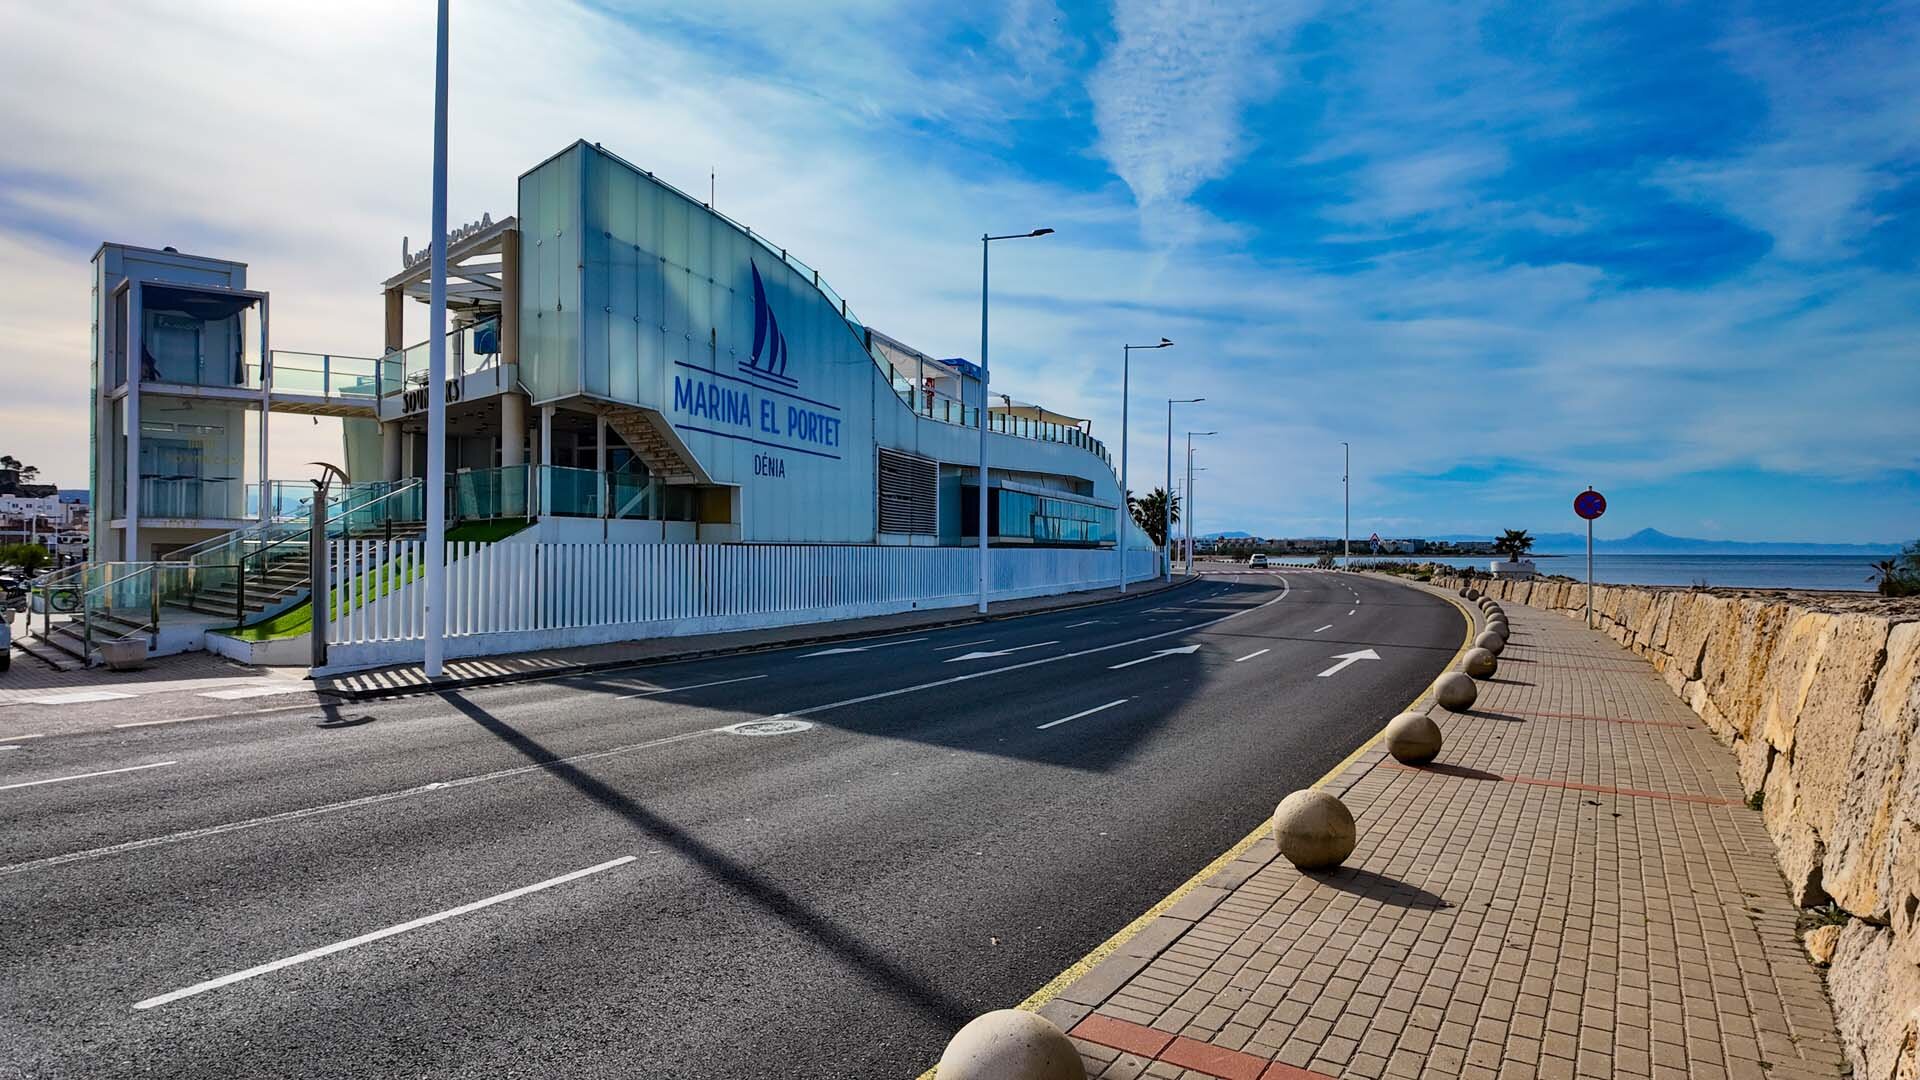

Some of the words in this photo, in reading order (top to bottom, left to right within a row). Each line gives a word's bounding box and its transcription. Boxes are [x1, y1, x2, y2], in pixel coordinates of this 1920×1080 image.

[674, 375, 751, 427] MARINA
[761, 400, 780, 434] EL
[788, 406, 841, 447] PORTET
[754, 452, 785, 478] DÉNIA
